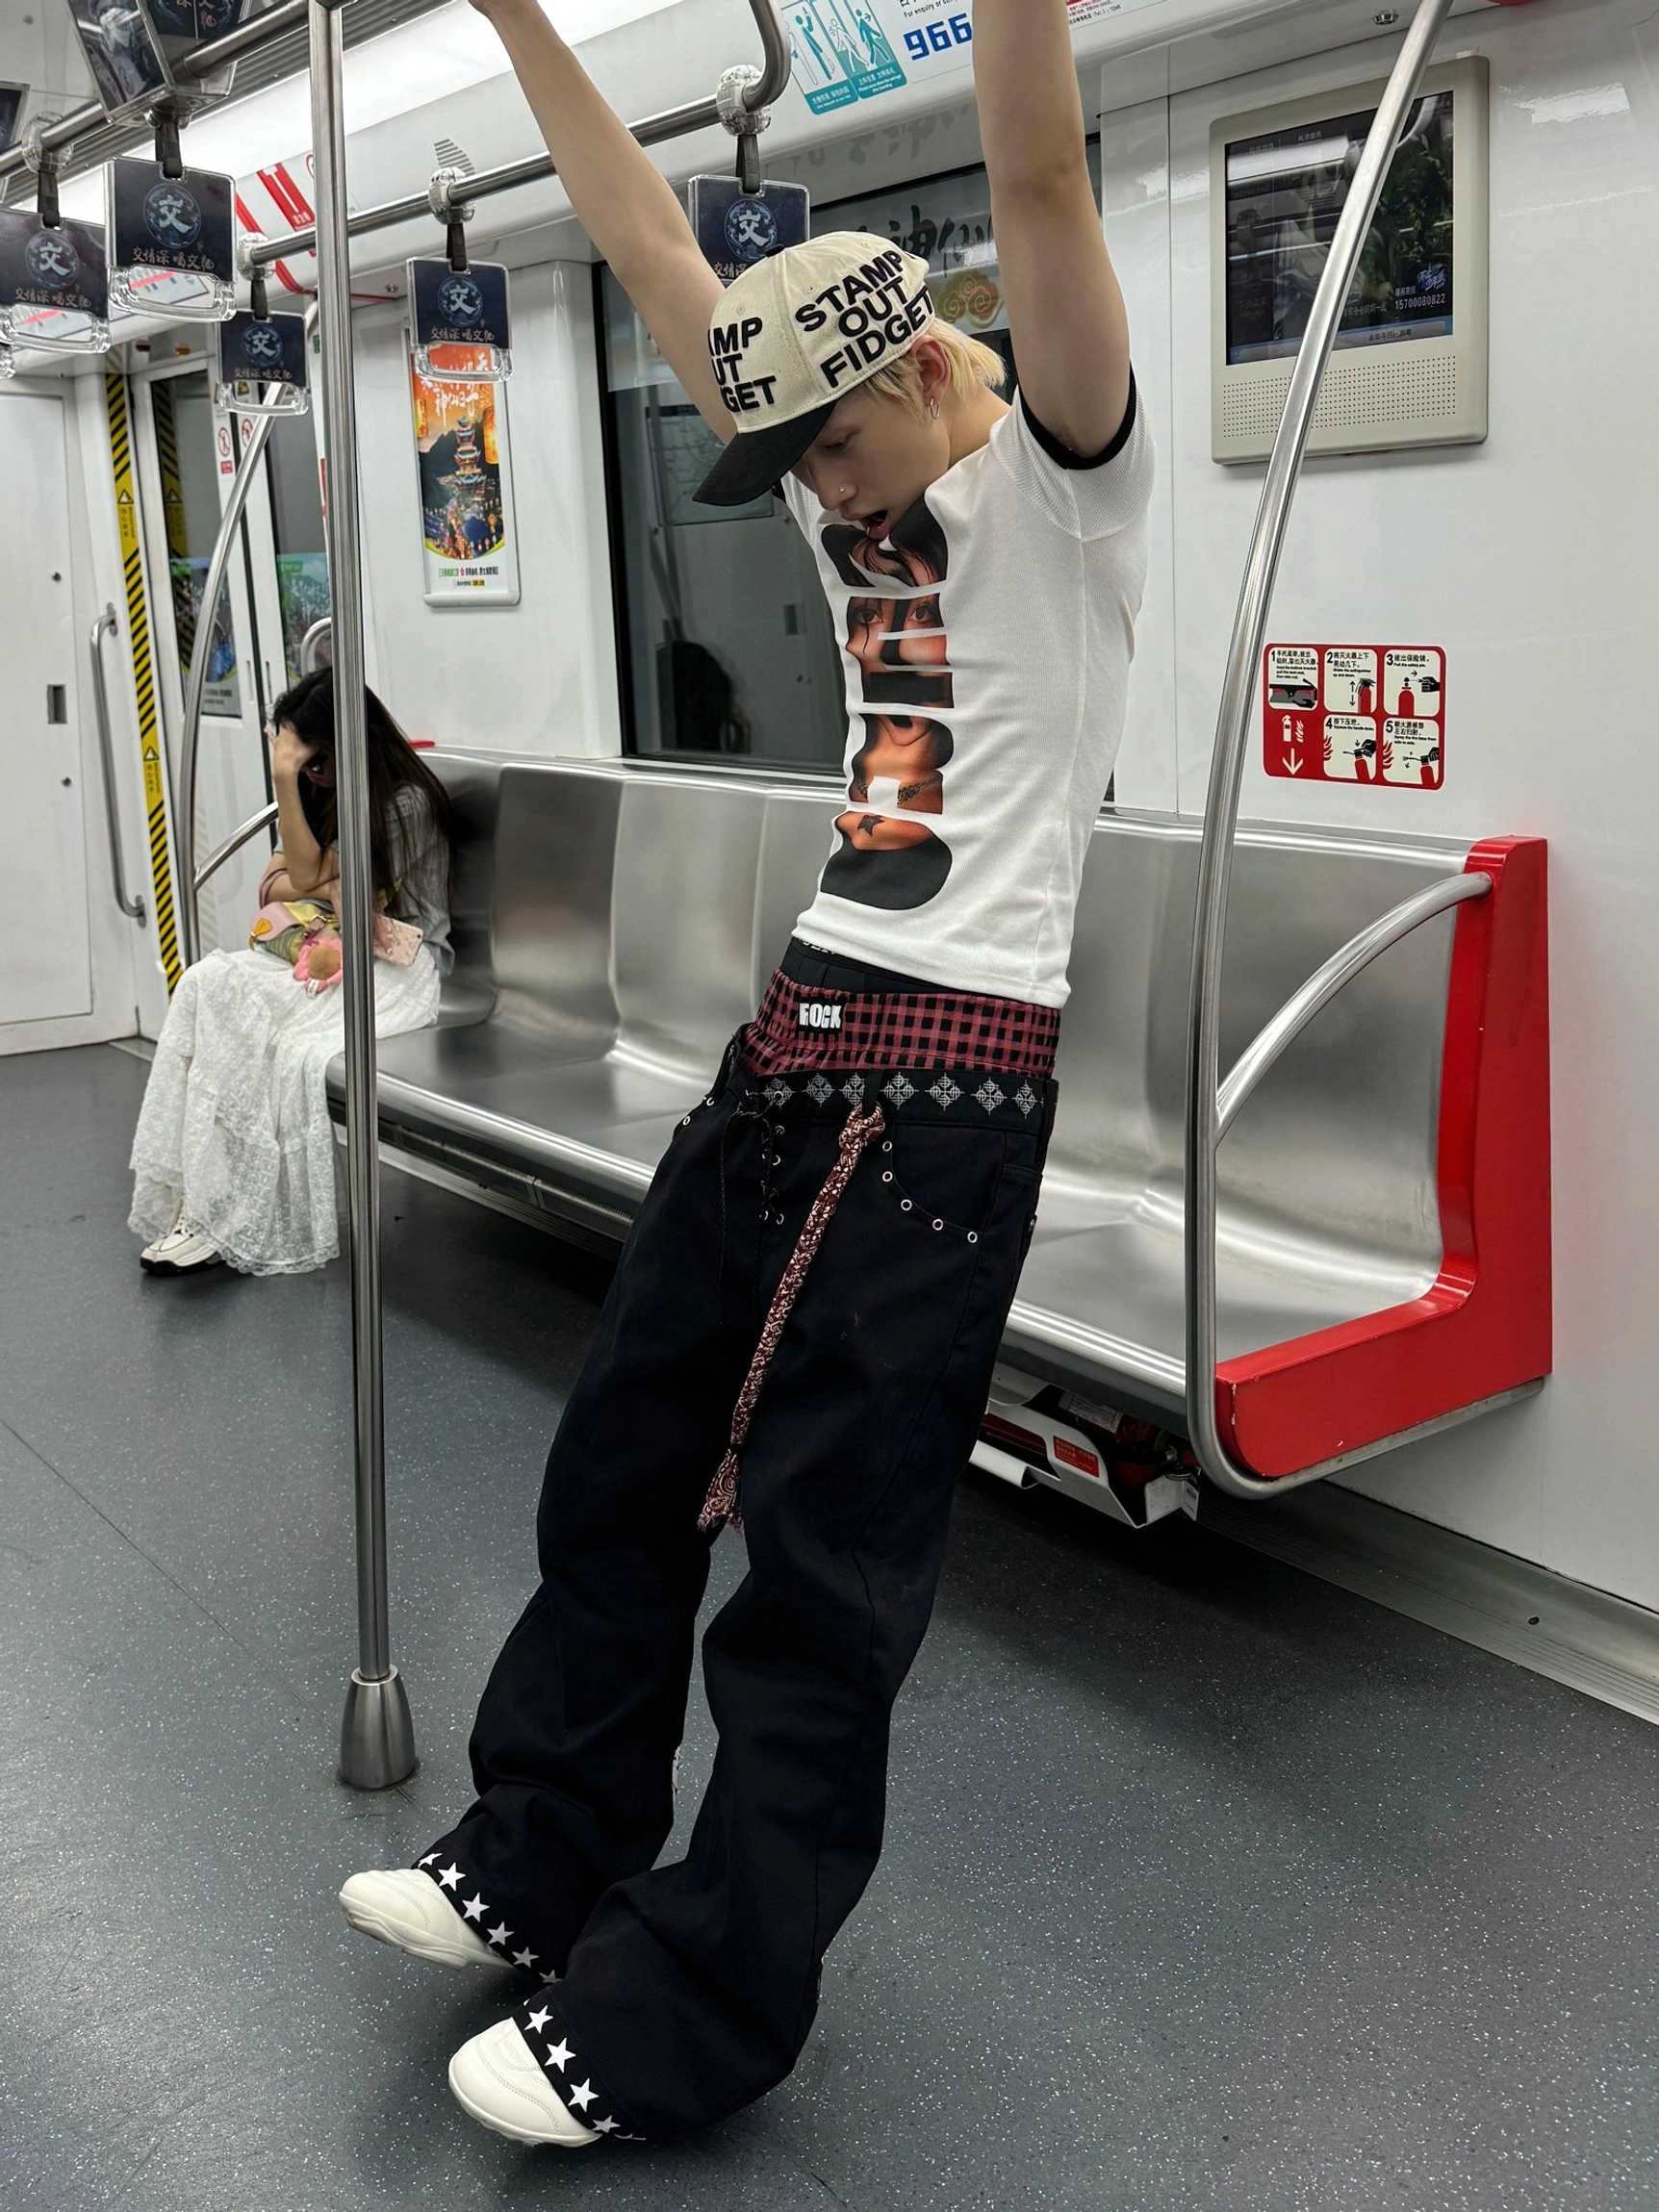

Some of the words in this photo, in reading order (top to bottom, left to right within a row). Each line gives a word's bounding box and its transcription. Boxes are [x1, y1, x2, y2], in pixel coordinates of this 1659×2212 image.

[795, 250, 903, 332] STAMP
[838, 276, 907, 337] OUT
[820, 285, 933, 389] FIDGET
[1271, 650, 1276, 661] 1
[1327, 651, 1333, 663] 2
[1386, 653, 1394, 666] 3
[1326, 717, 1333, 729] 4
[1386, 721, 1393, 733] 5
